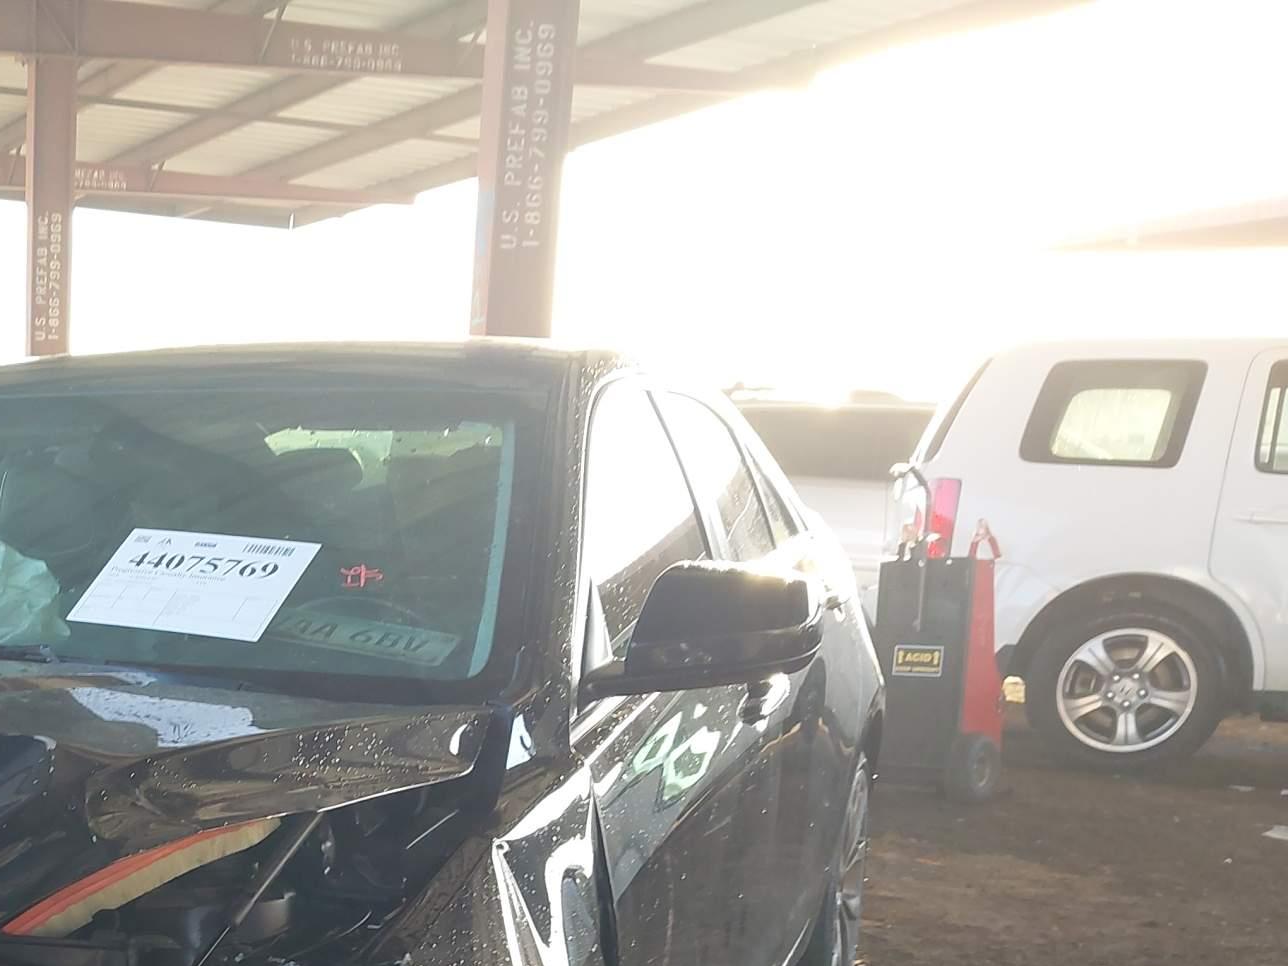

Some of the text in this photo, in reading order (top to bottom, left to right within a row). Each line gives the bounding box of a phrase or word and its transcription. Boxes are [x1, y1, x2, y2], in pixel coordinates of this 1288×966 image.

[500, 19, 534, 249] U.S. PREFAB INC.
[522, 23, 556, 247] 1-866-799-0969
[34, 209, 49, 342] U.S. PREFAB INC.
[47, 211, 62, 341] 1-866-799-0969
[128, 550, 280, 578] 44075769
